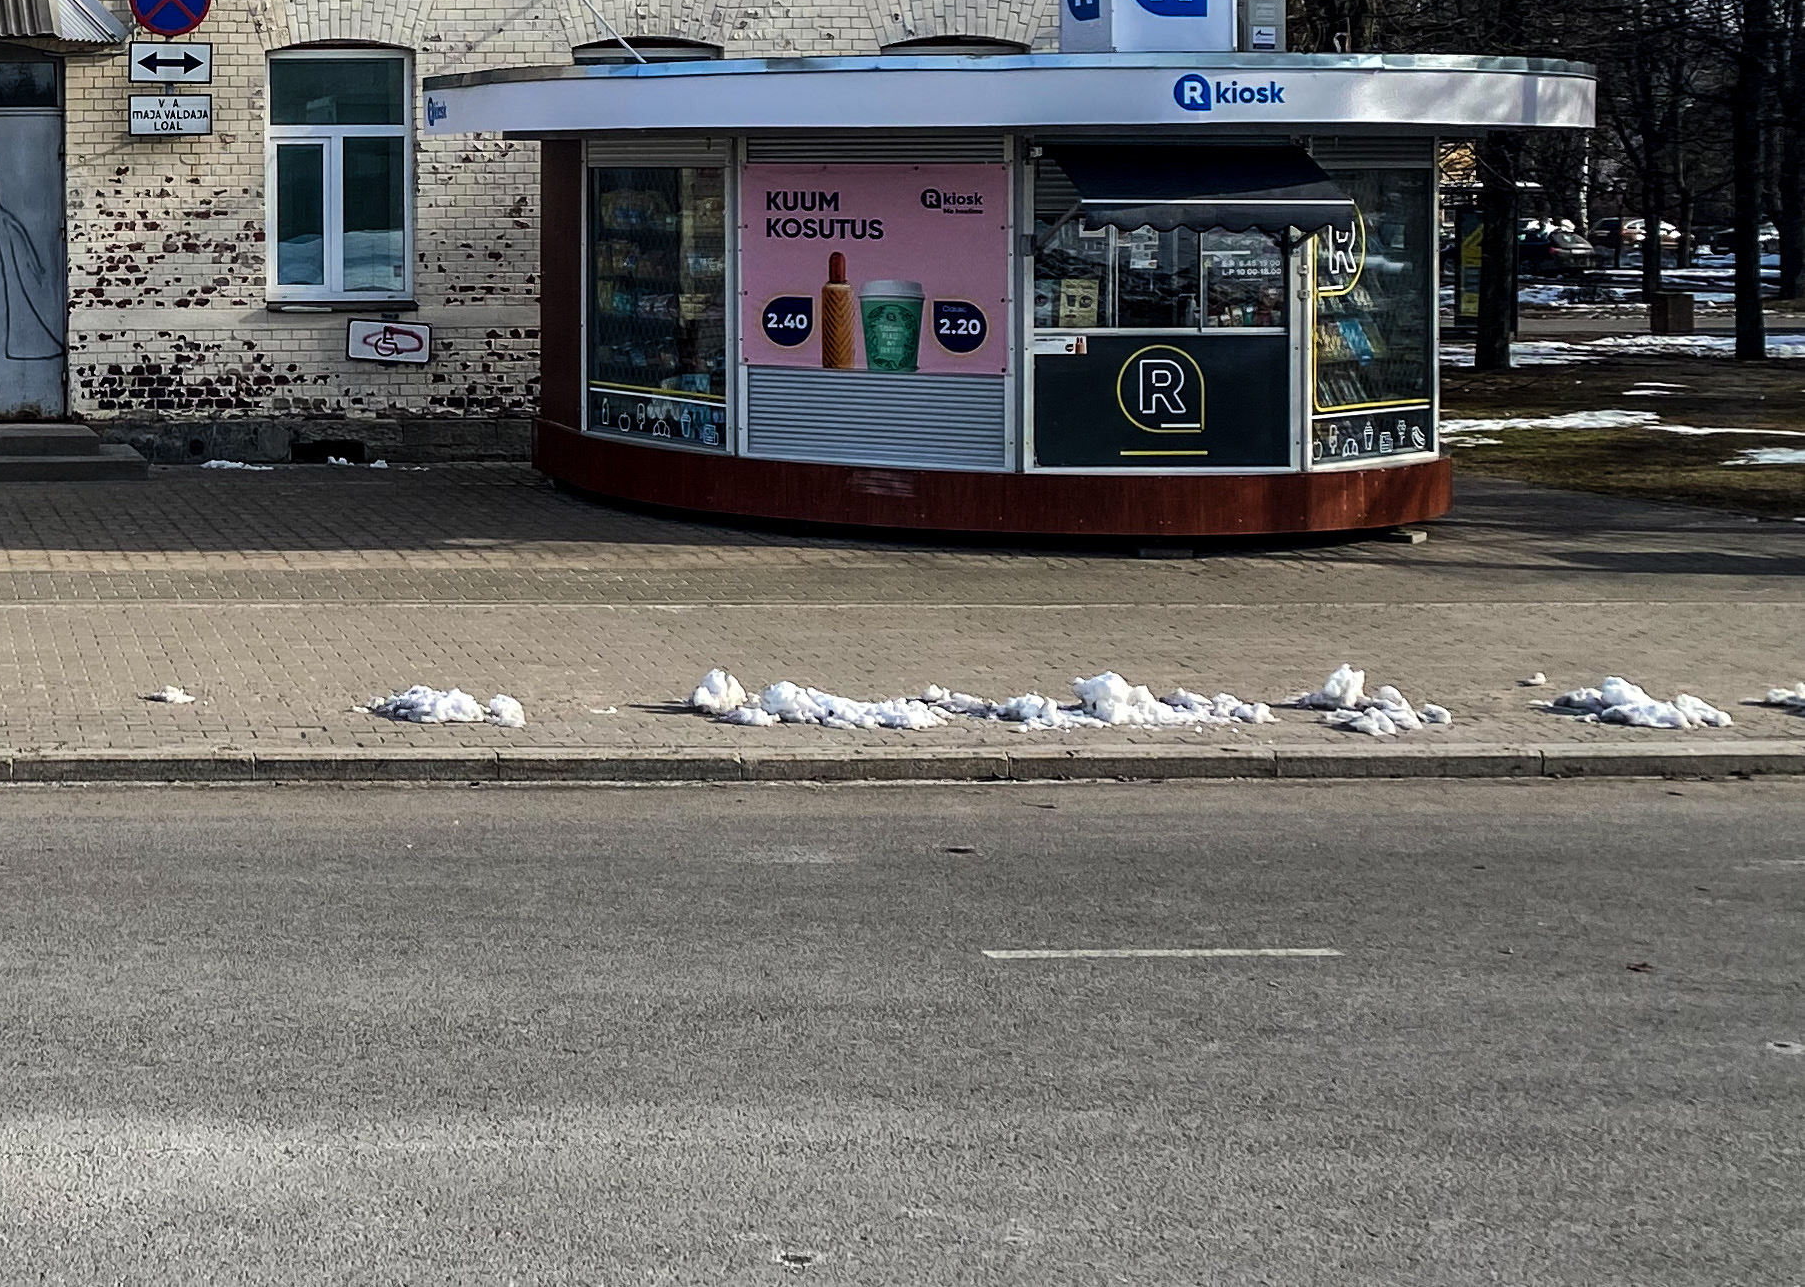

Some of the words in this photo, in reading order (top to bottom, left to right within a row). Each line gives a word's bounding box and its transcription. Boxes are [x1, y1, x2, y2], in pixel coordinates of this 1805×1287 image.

[1184, 81, 1204, 104] R
[1215, 81, 1285, 104] kiosk
[164, 109, 209, 120] VALDAJA
[154, 120, 183, 131] LOAL
[766, 191, 840, 212] KUUM
[943, 191, 983, 205] kiosk
[766, 218, 884, 240] KOSUTUS
[767, 313, 808, 329] 2.40
[939, 318, 981, 335] 2.20
[1139, 359, 1186, 413] R
